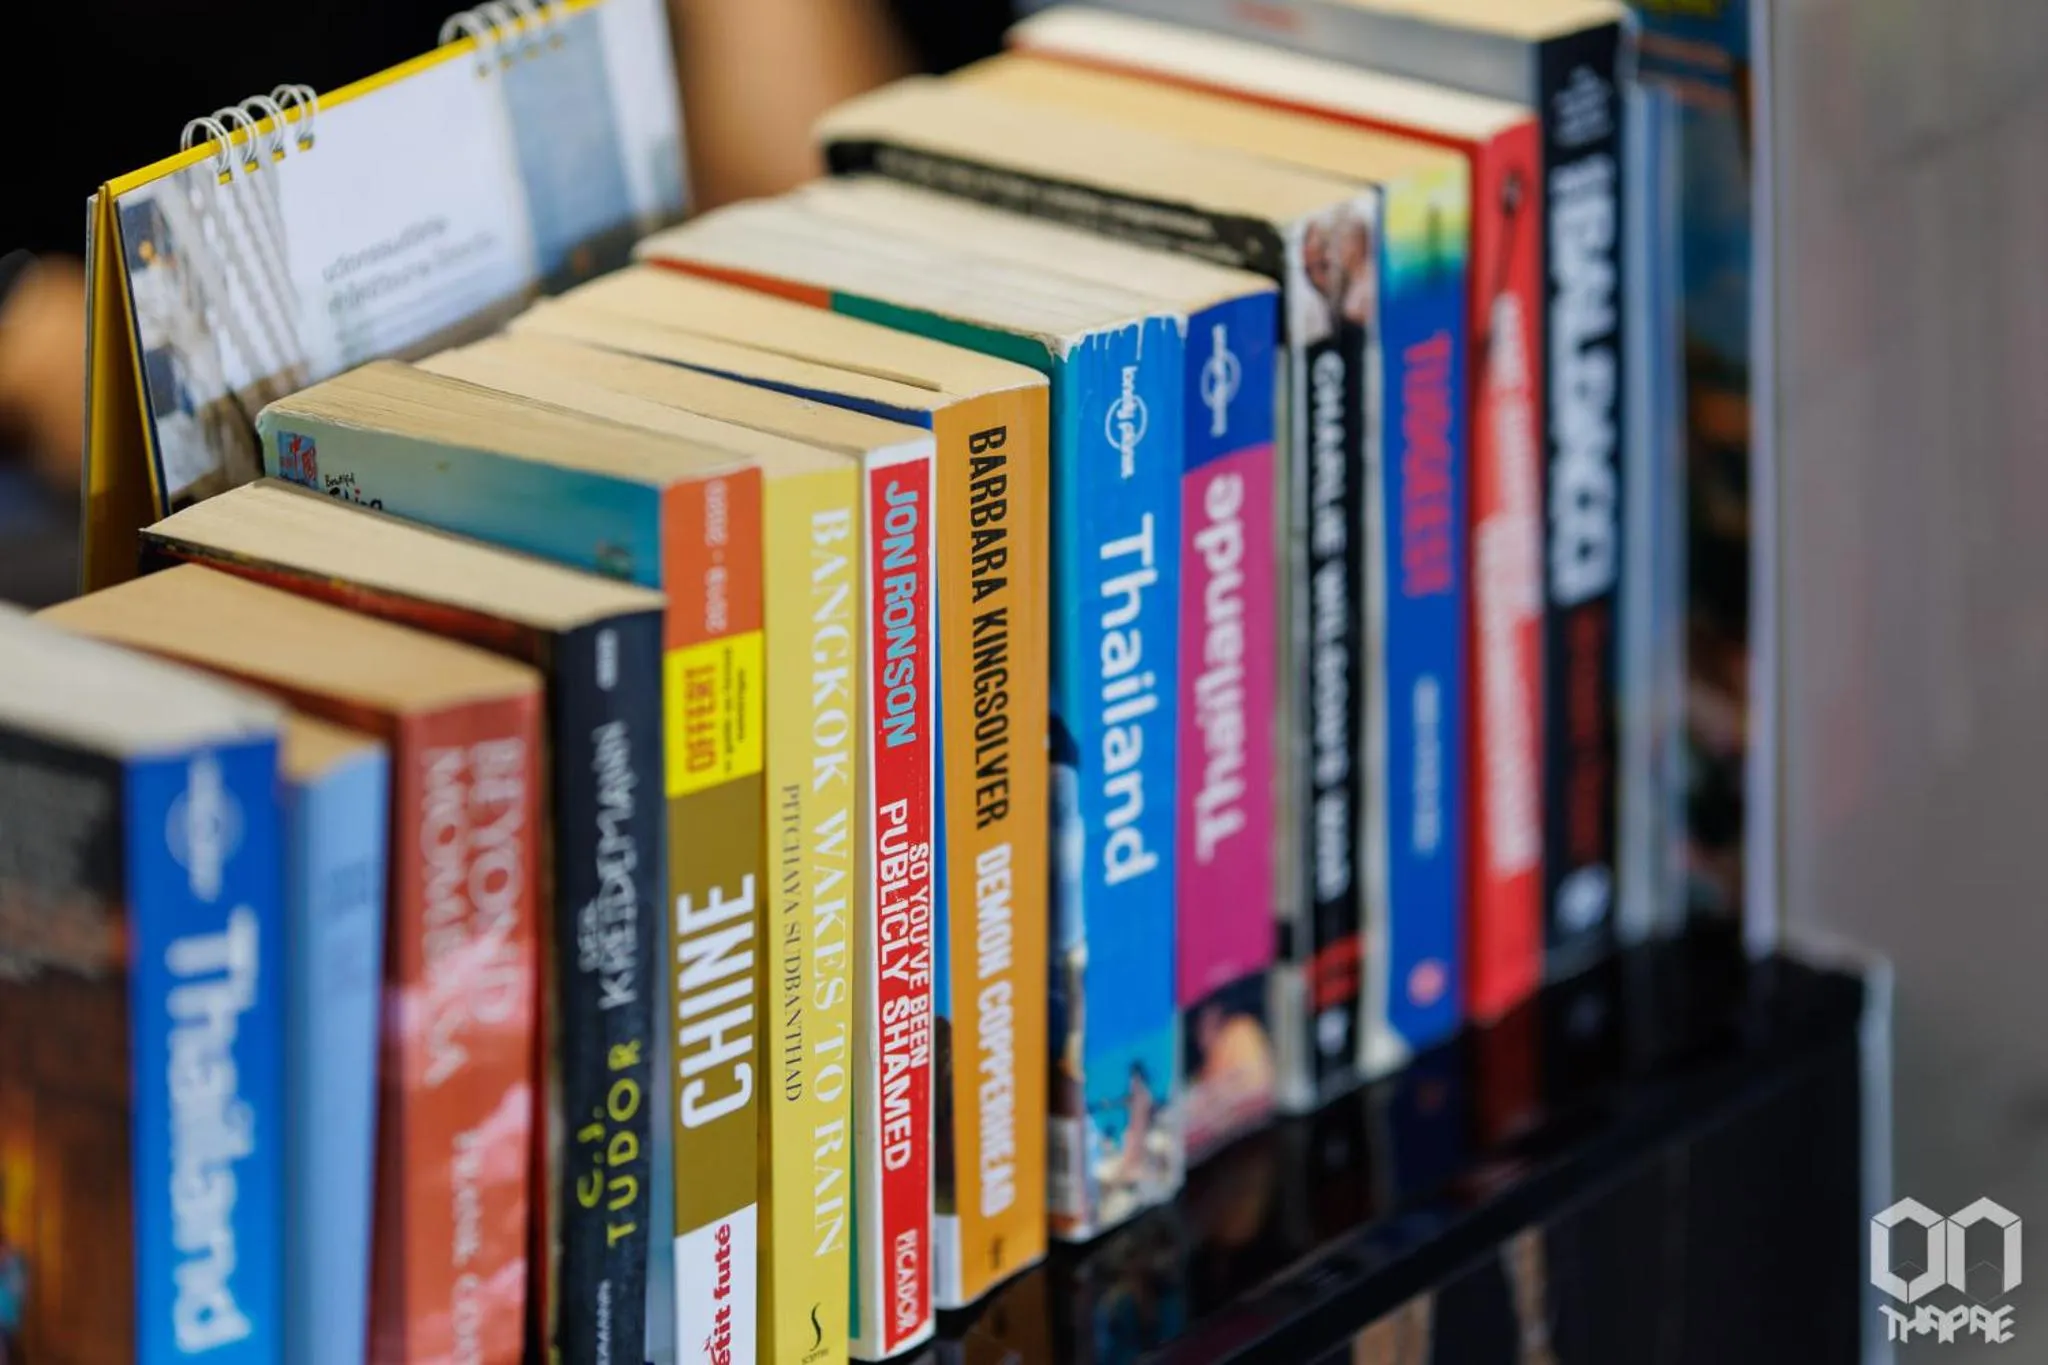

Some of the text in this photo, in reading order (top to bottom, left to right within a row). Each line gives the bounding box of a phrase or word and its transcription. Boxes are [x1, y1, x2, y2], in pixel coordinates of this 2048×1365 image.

[685, 663, 716, 774] OFFERT
[882, 480, 918, 749] JON RONSON
[968, 424, 1011, 830] BARBARA KINGSOLVER
[1100, 512, 1159, 887] Thailand
[678, 871, 755, 1130] CHINE
[781, 783, 803, 1102] PITCHAYA SUDBANTHAD
[810, 508, 852, 1259] BANGKOK WAKES TO RAIN
[879, 798, 911, 1172] PUBLICLY SHAMED
[910, 842, 930, 1068] SO YOU'VE BEEN
[976, 842, 1016, 1217] DEMON COPPERHEAD
[165, 902, 261, 1356] Thailand
[607, 1038, 642, 1249] TUDOR
[713, 1223, 732, 1299] futé
[895, 1228, 919, 1334] PICADOR
